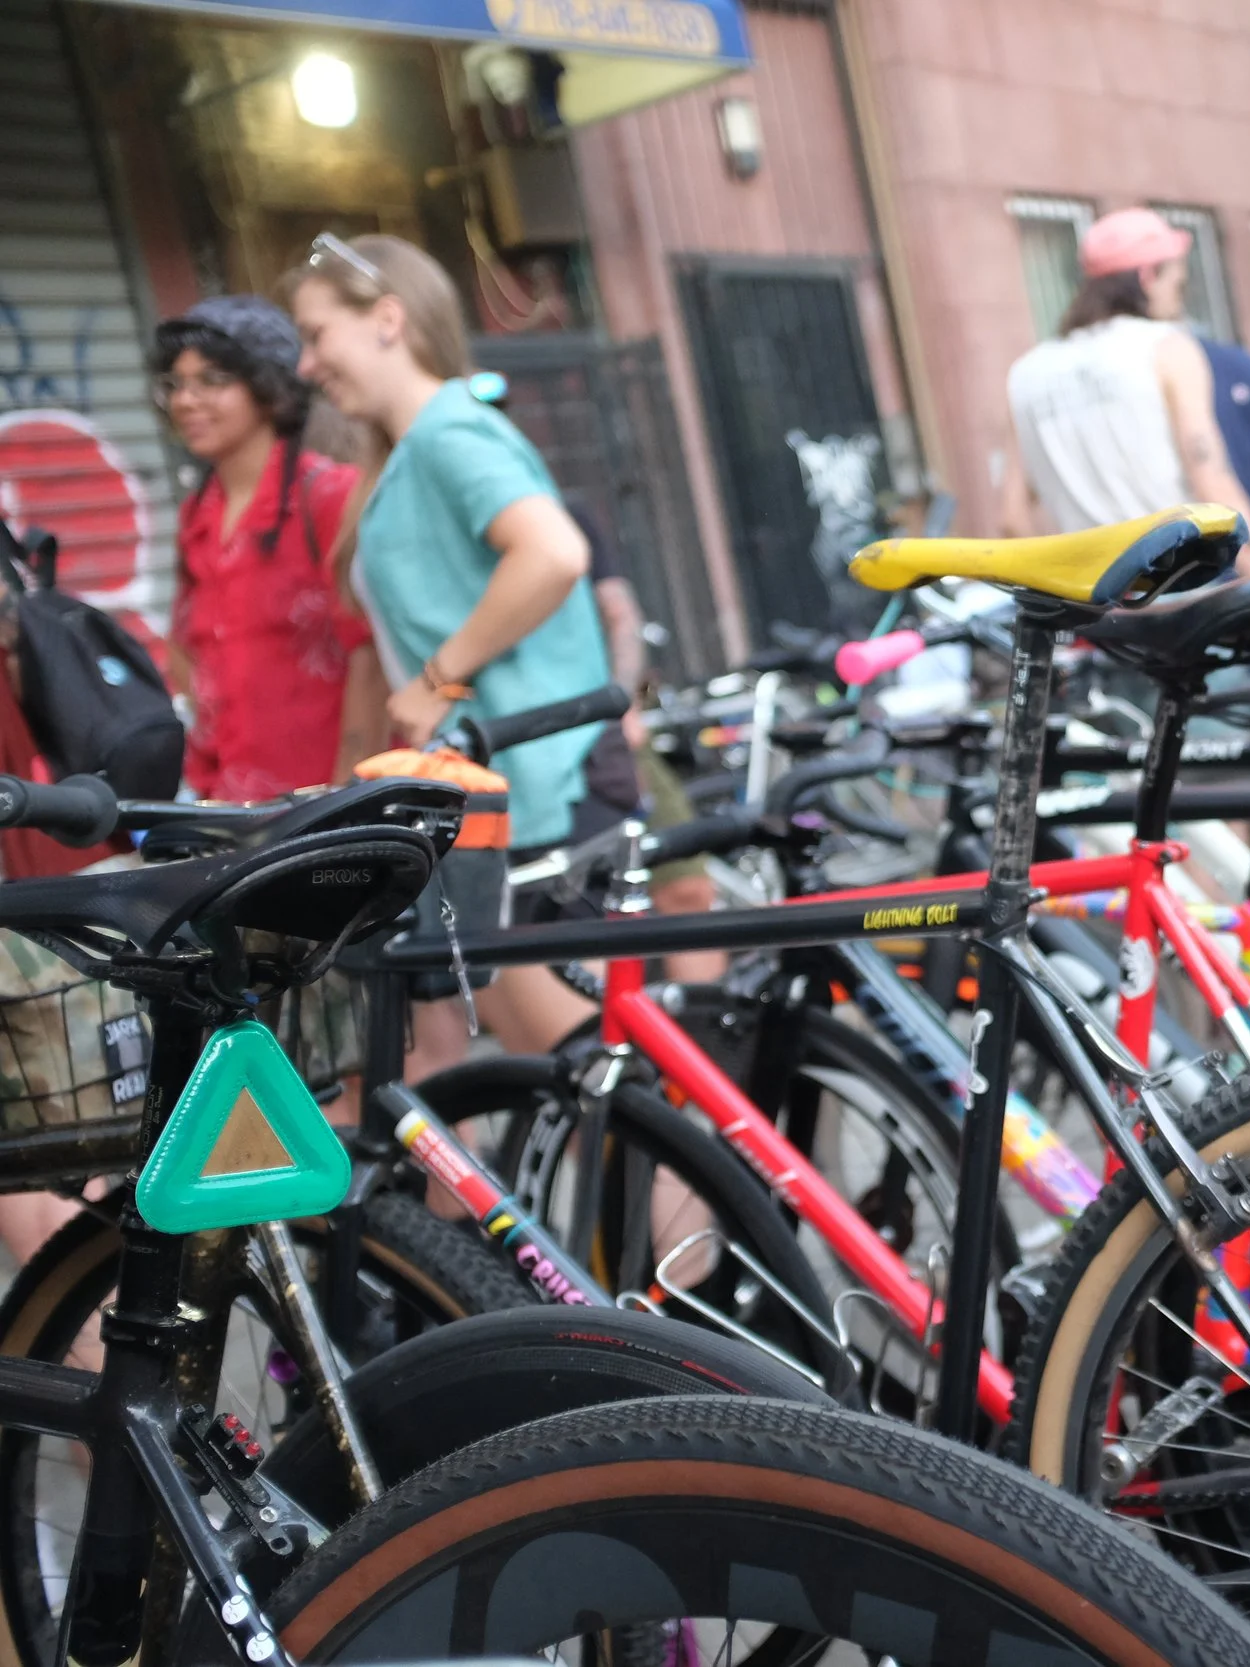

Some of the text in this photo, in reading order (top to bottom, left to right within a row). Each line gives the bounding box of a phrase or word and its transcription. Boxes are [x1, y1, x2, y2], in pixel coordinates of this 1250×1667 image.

[312, 869, 372, 884] BROOKS
[863, 902, 958, 930] LIGHTNING BOLT
[516, 1244, 592, 1306] CRUS
